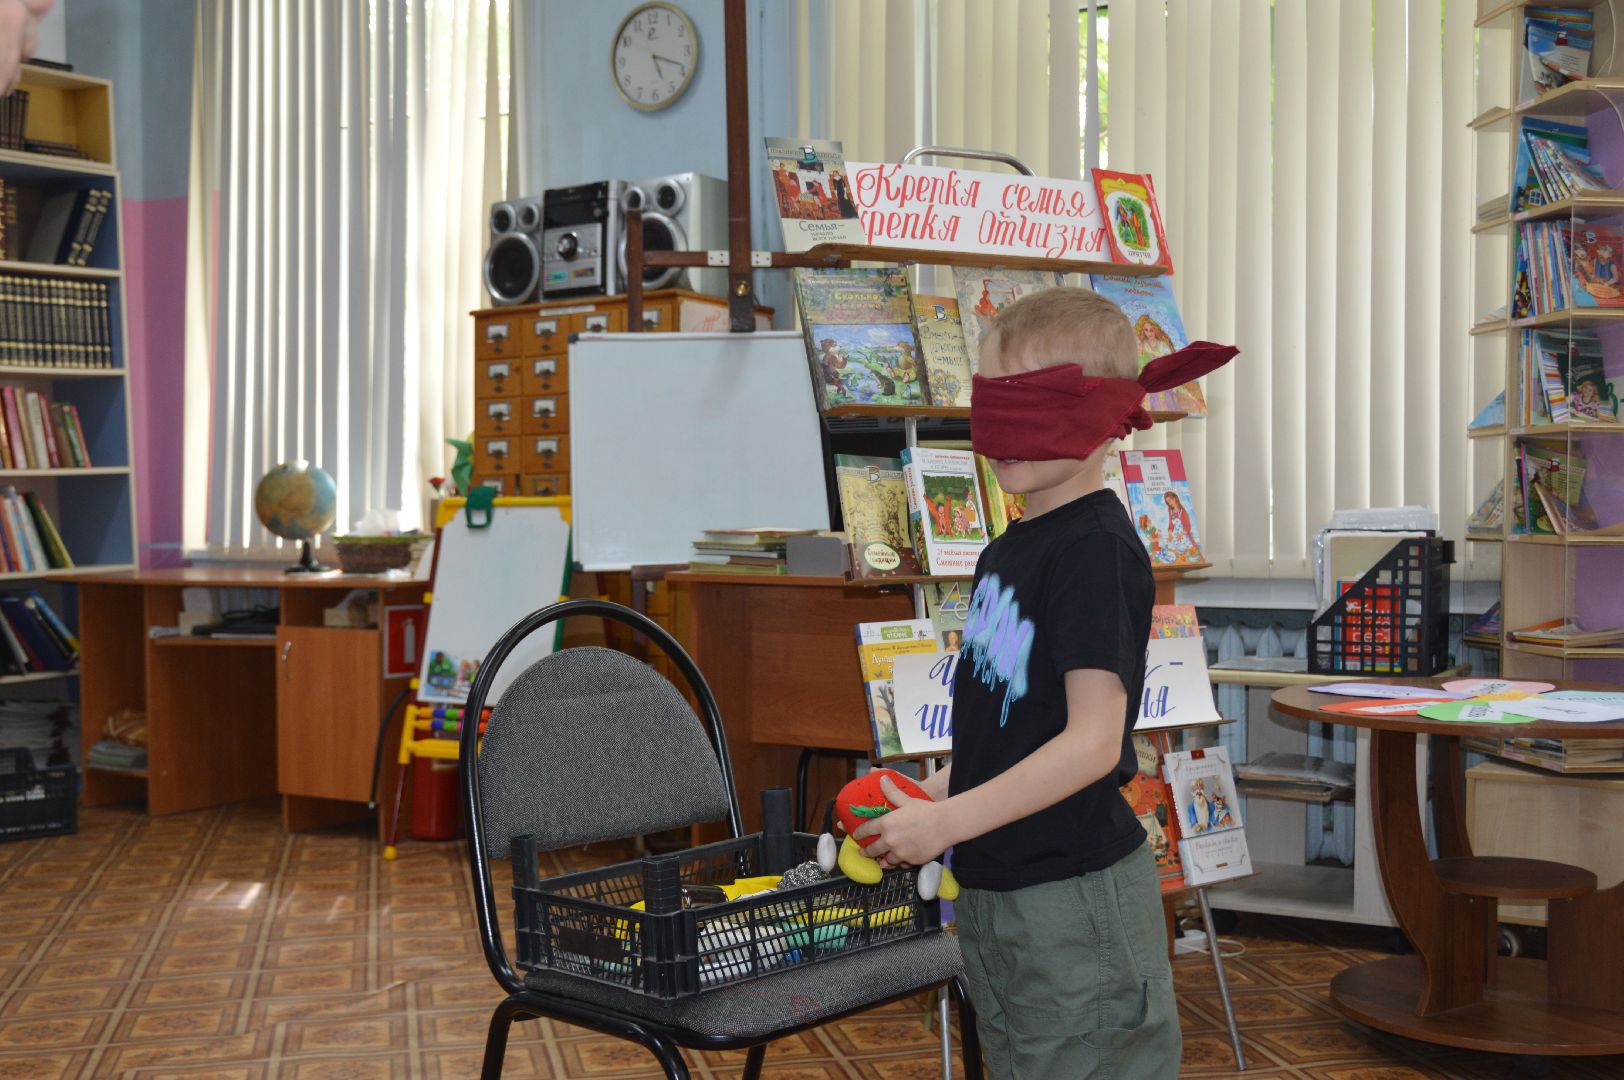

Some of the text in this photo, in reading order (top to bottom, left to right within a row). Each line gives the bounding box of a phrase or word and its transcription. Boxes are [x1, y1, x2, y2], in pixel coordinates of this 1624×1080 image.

[855, 163, 1097, 218] Крепка семья
[978, 209, 1107, 259] Отчизна
